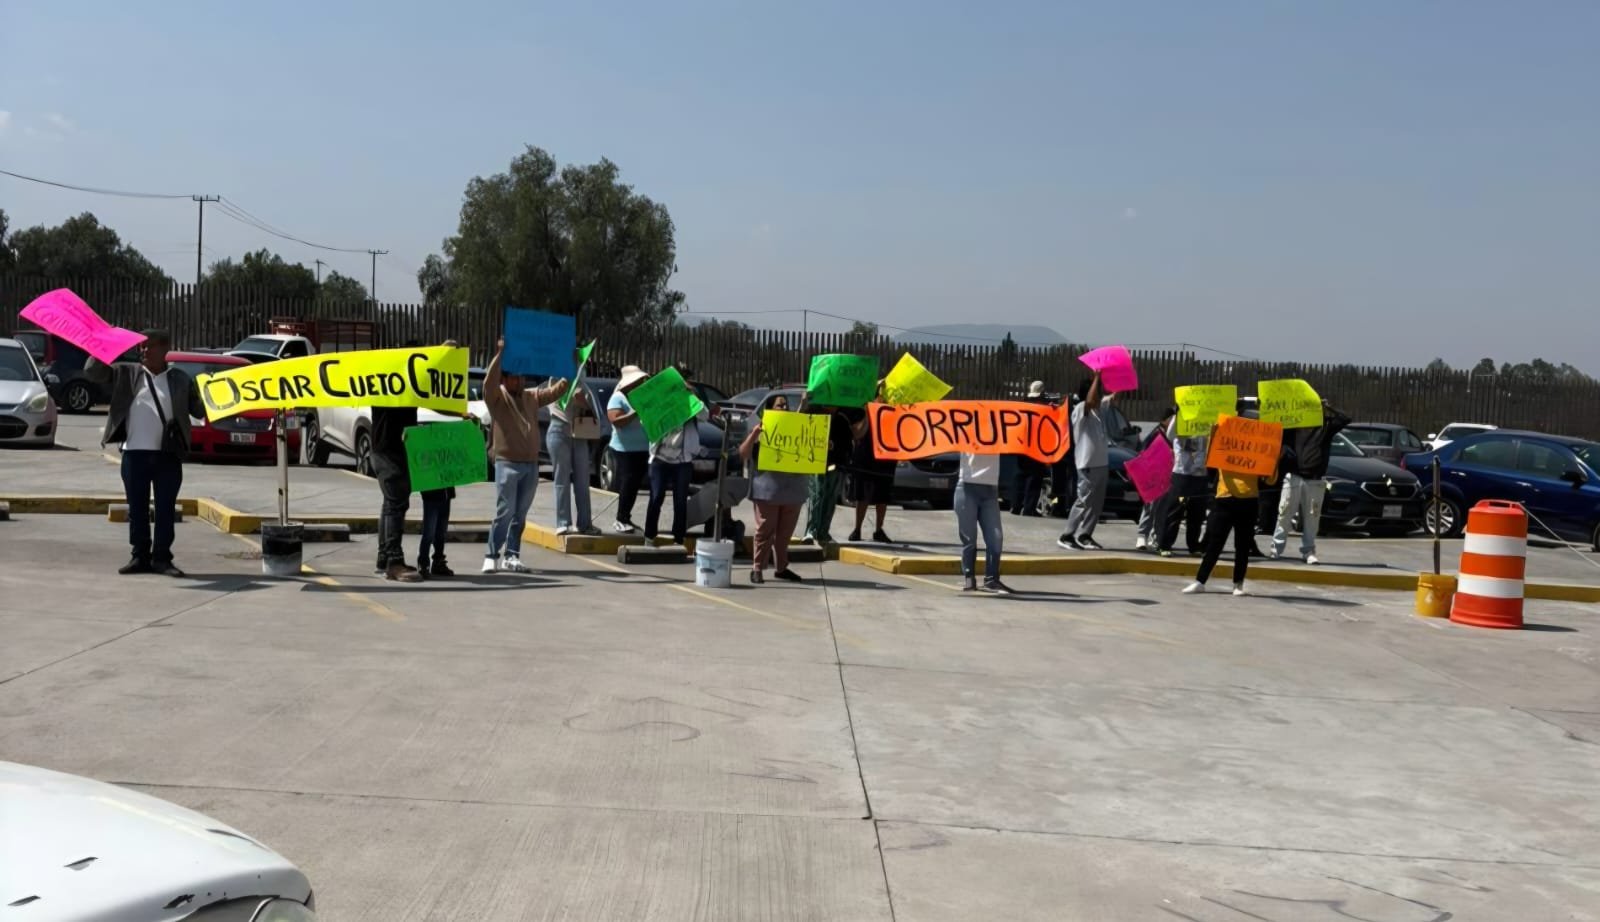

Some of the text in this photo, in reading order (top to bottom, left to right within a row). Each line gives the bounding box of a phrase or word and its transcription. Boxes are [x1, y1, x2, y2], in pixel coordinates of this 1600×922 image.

[203, 352, 466, 411] OSCAR CUETO CRUZ
[877, 405, 1061, 456] CORRUPTO
